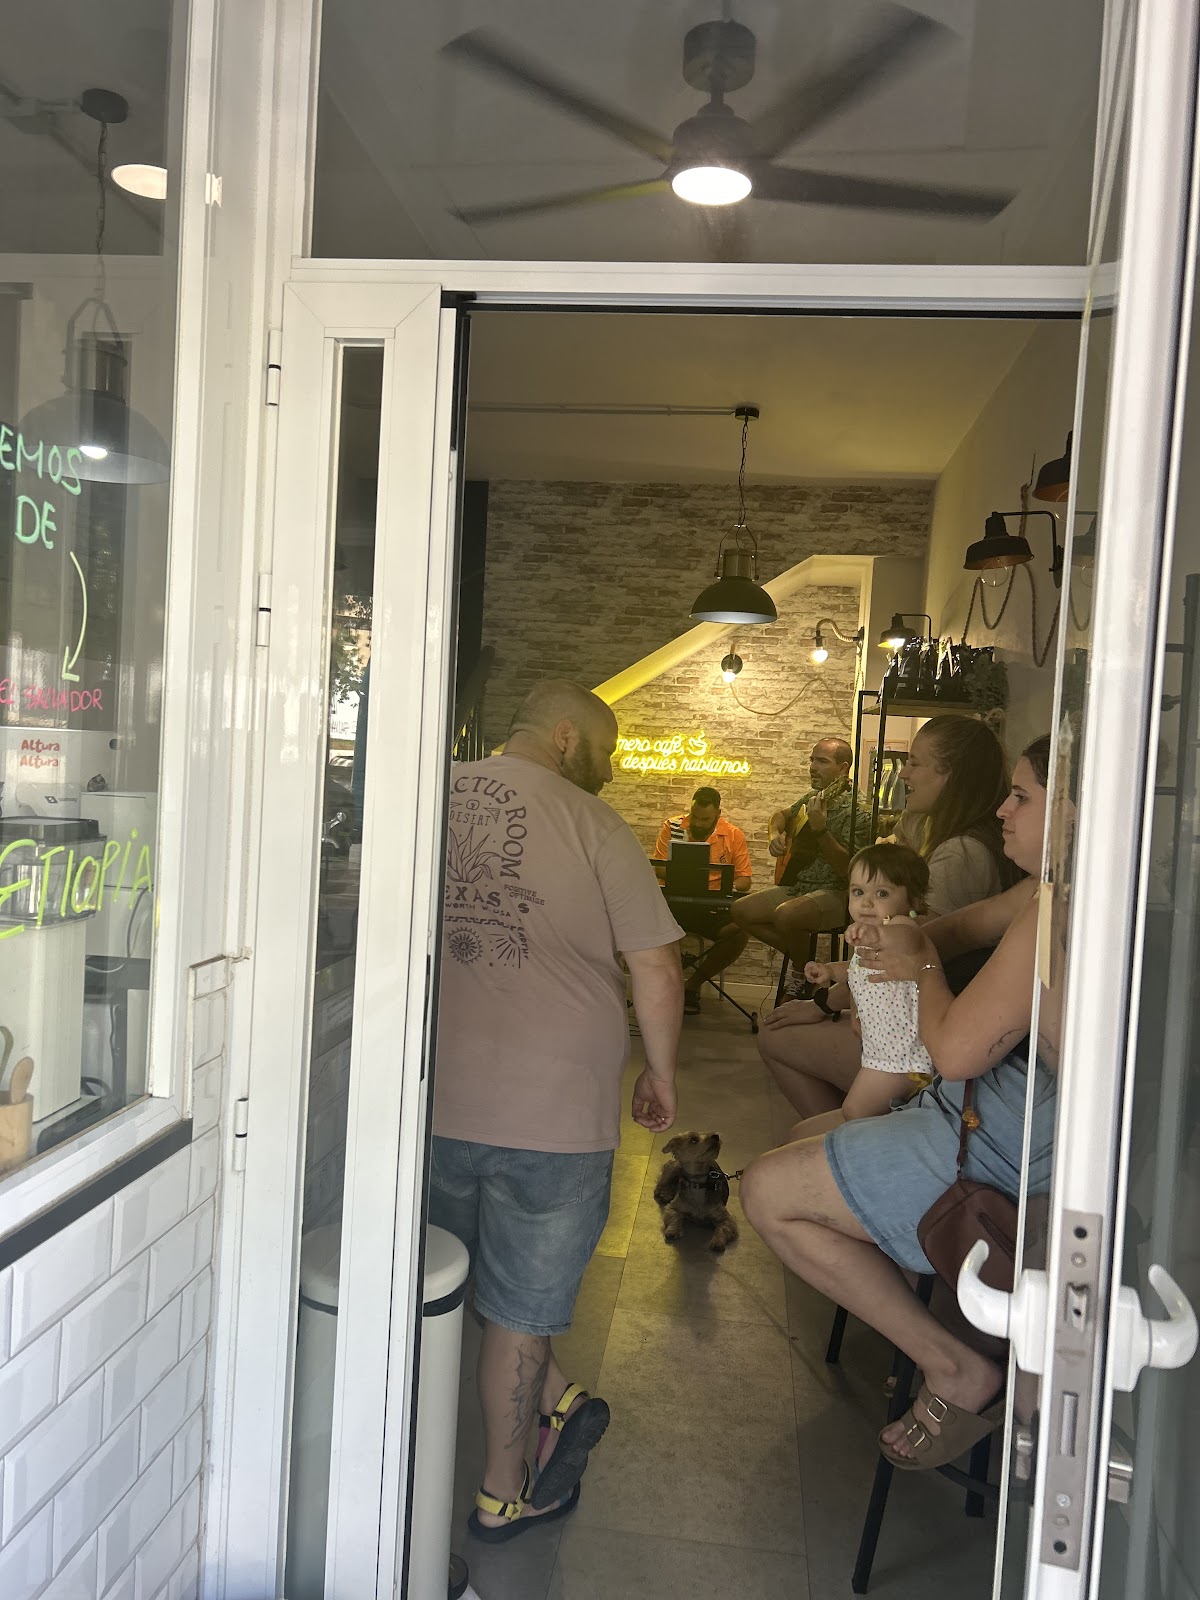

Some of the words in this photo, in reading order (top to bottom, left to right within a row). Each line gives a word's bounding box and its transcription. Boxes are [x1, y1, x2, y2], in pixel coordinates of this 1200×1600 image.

[0, 424, 82, 495] EMOS
[15, 495, 57, 549] DE
[0, 678, 15, 704] EL
[24, 684, 103, 712] SALVADOR
[21, 739, 60, 753] Altura
[19, 755, 59, 769] Altura
[679, 756, 750, 775] hablamos
[449, 810, 491, 826] DESERT
[450, 776, 518, 804] CTUS
[499, 805, 528, 881] ROOM
